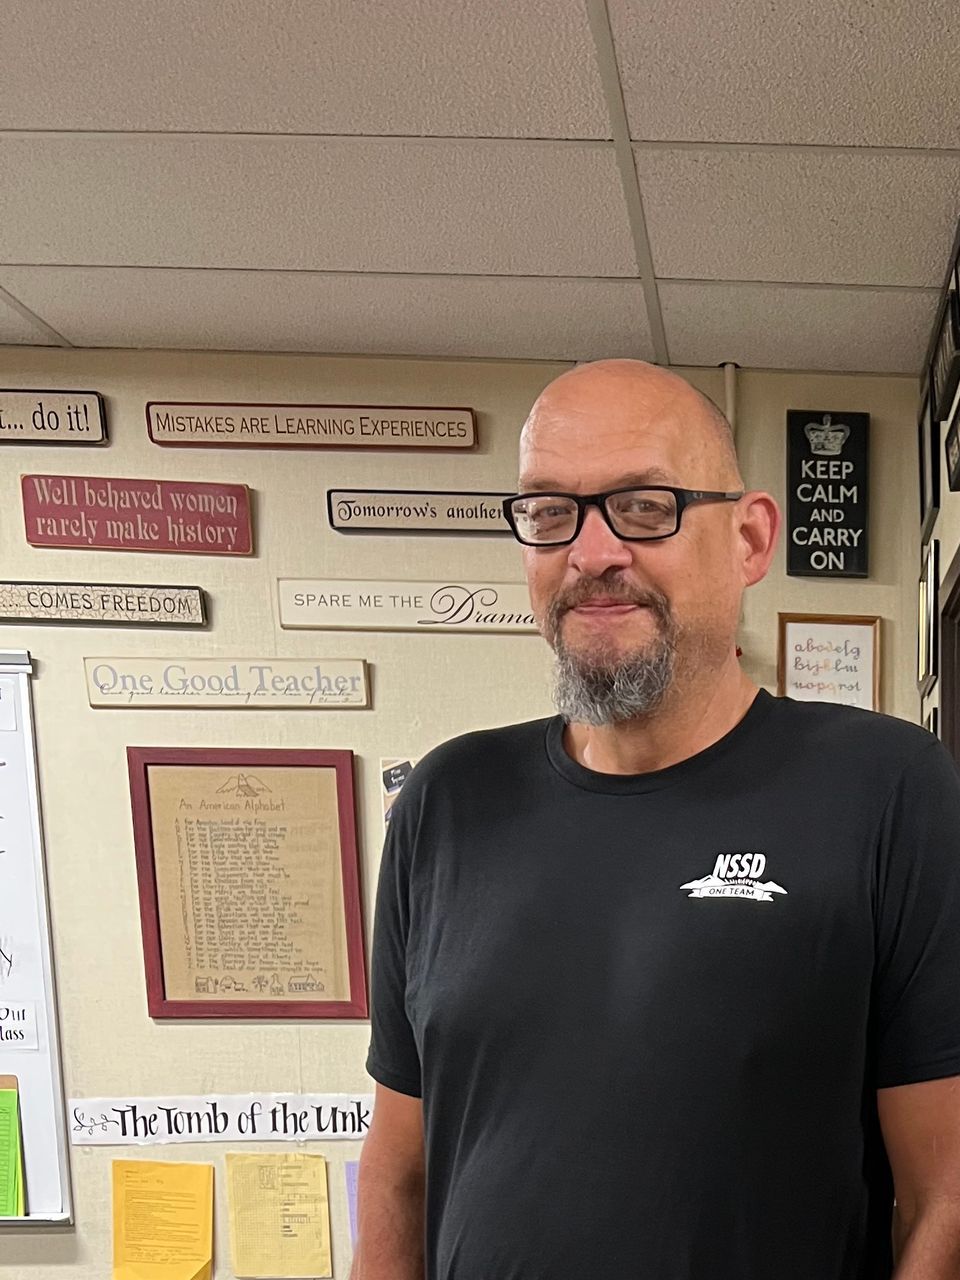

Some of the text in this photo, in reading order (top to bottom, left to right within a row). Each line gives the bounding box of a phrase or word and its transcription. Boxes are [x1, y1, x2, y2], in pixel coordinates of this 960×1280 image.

[32, 402, 60, 431] do
[67, 404, 90, 432] it!
[156, 412, 467, 438] MISTAKES ARE LEARNING EXPERIENCES
[801, 460, 854, 479] KEEP
[32, 478, 238, 517] Well behaved women
[796, 484, 858, 503] CALM
[337, 500, 437, 522] Tomorrow's
[810, 508, 845, 522] AND
[36, 512, 238, 550] rarely make history
[792, 527, 863, 547] CARRY
[810, 551, 845, 570] ON
[27, 592, 93, 610] COMES
[101, 594, 191, 614] FREEDOM
[294, 585, 536, 625] SPARE ME THE Drama
[92, 664, 361, 692] One Good Teacher
[712, 853, 767, 879] NSSD
[708, 887, 755, 896] ONE TEAM
[111, 1100, 371, 1138] The Tomb of the Unk
